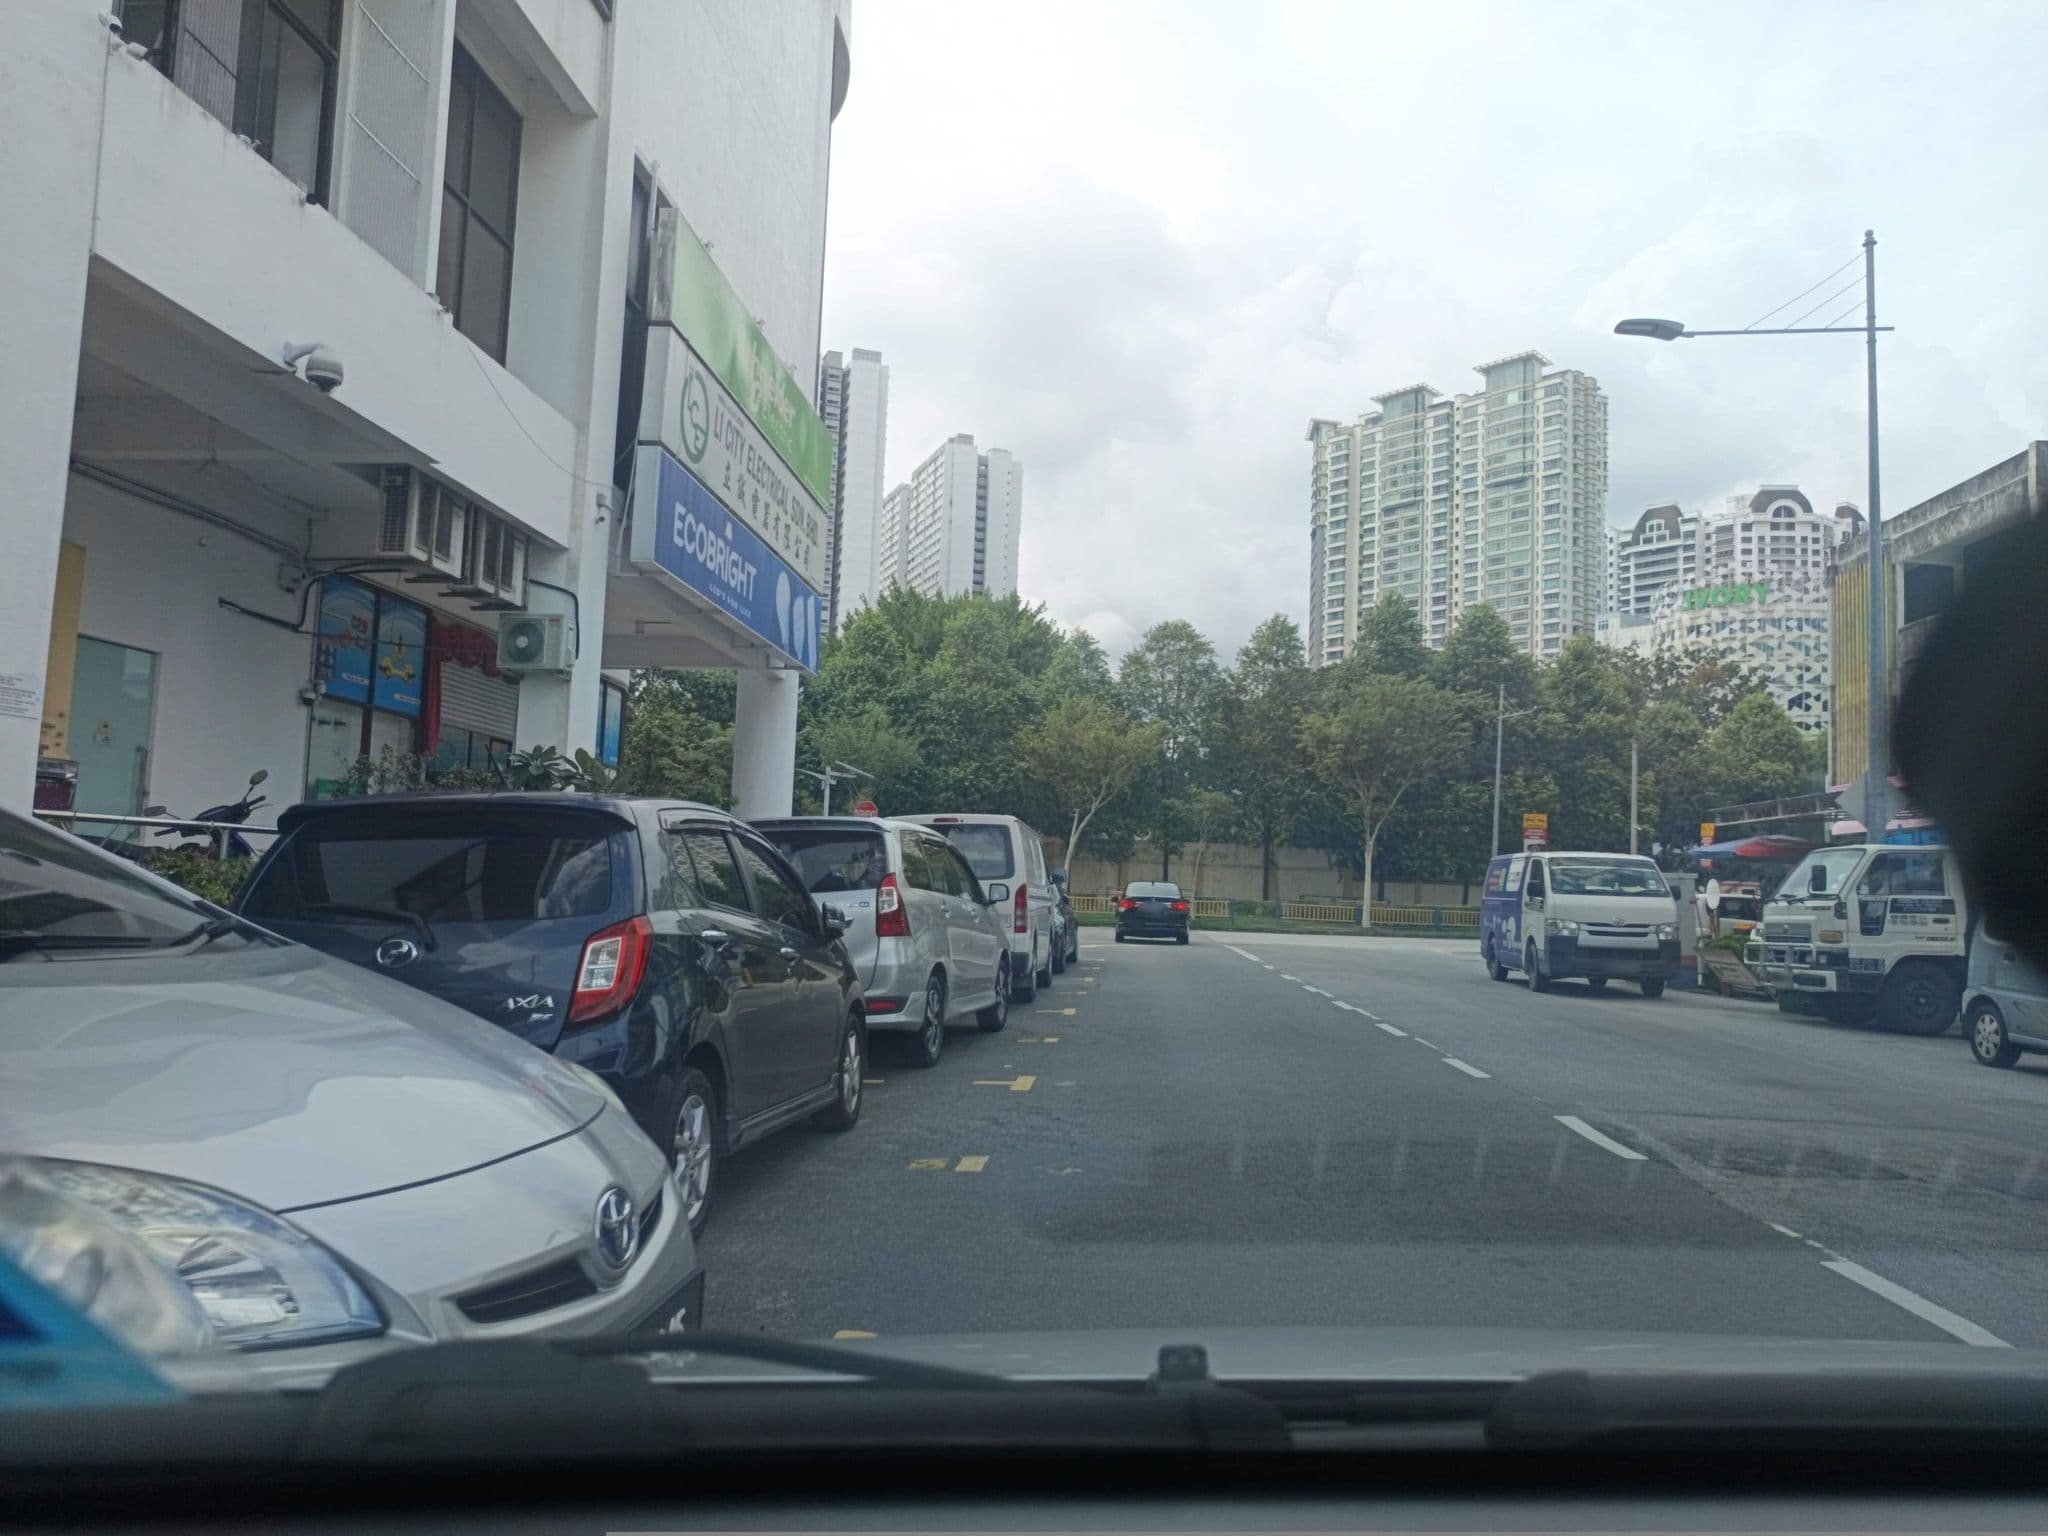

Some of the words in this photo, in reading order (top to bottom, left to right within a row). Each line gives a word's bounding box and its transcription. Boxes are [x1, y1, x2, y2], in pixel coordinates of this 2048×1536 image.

[725, 420, 746, 465] CITY
[747, 443, 788, 516] ELECTRICAL
[673, 501, 757, 602] ECOBRIGHT
[1685, 581, 1771, 610] IVORY
[496, 994, 554, 1010] AXIA
